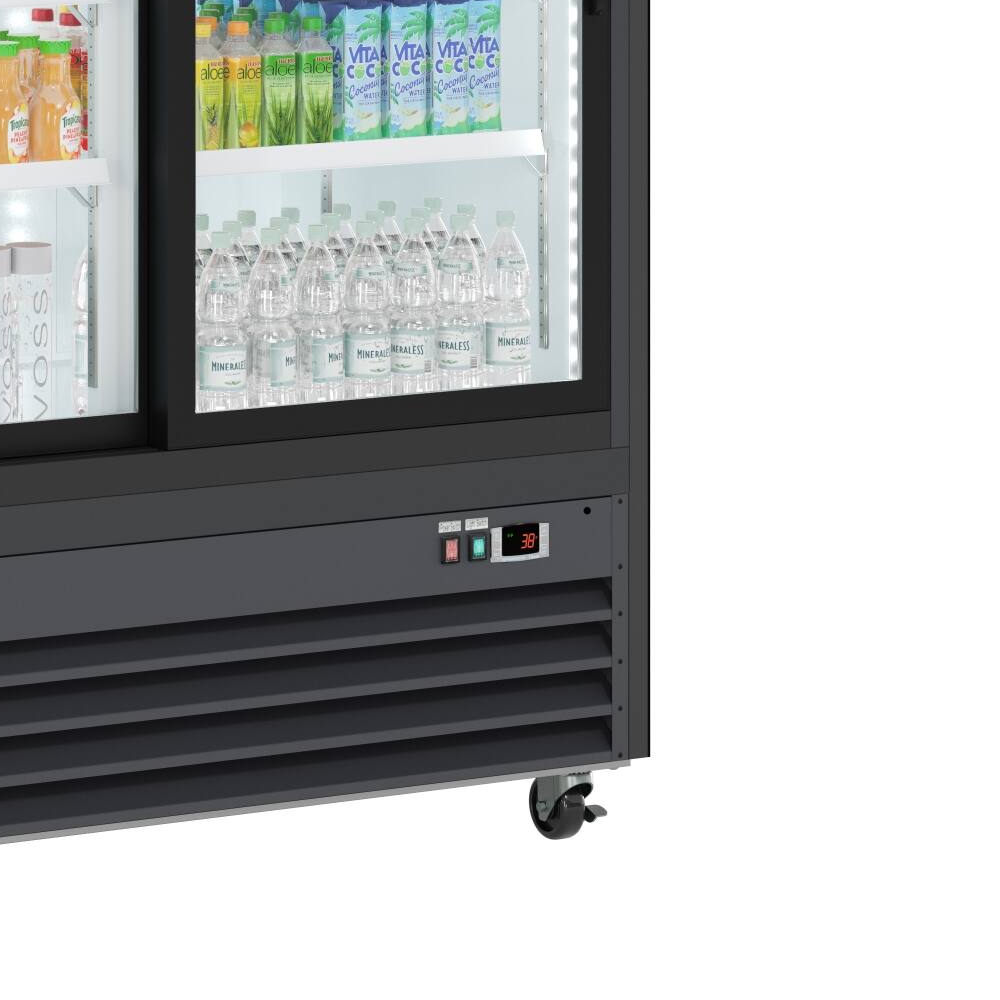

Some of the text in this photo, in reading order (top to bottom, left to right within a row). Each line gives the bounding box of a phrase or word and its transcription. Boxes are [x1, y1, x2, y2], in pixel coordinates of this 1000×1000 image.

[349, 44, 380, 63] VITA
[394, 41, 425, 61] VITA
[438, 39, 468, 58] VITA
[470, 35, 499, 53] VITA
[265, 61, 296, 77] aloe
[33, 289, 48, 420] VOSS
[521, 533, 535, 549] 38
